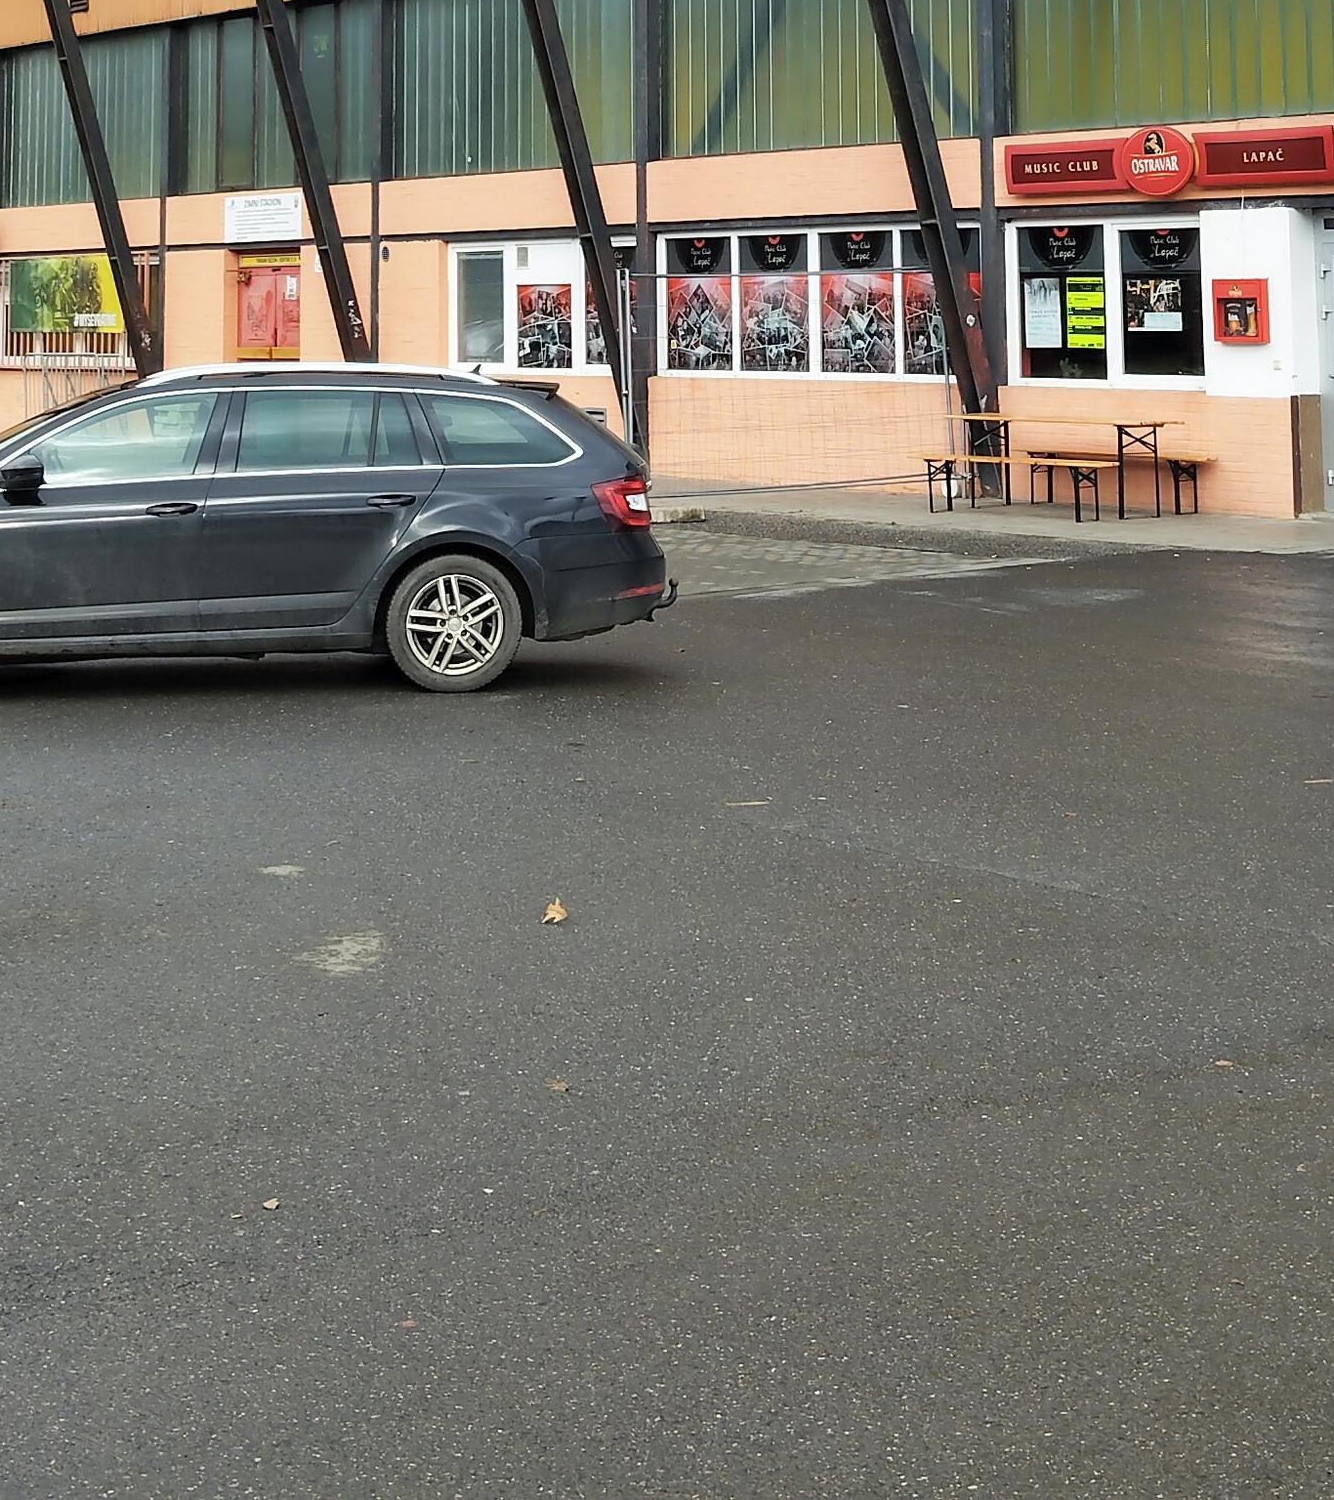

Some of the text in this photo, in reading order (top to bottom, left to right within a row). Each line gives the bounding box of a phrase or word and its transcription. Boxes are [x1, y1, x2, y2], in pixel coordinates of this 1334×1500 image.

[1243, 147, 1285, 163] LAPAČ
[1024, 160, 1099, 174] MUSIC CLUB
[1131, 155, 1180, 176] OSTRAVAR
